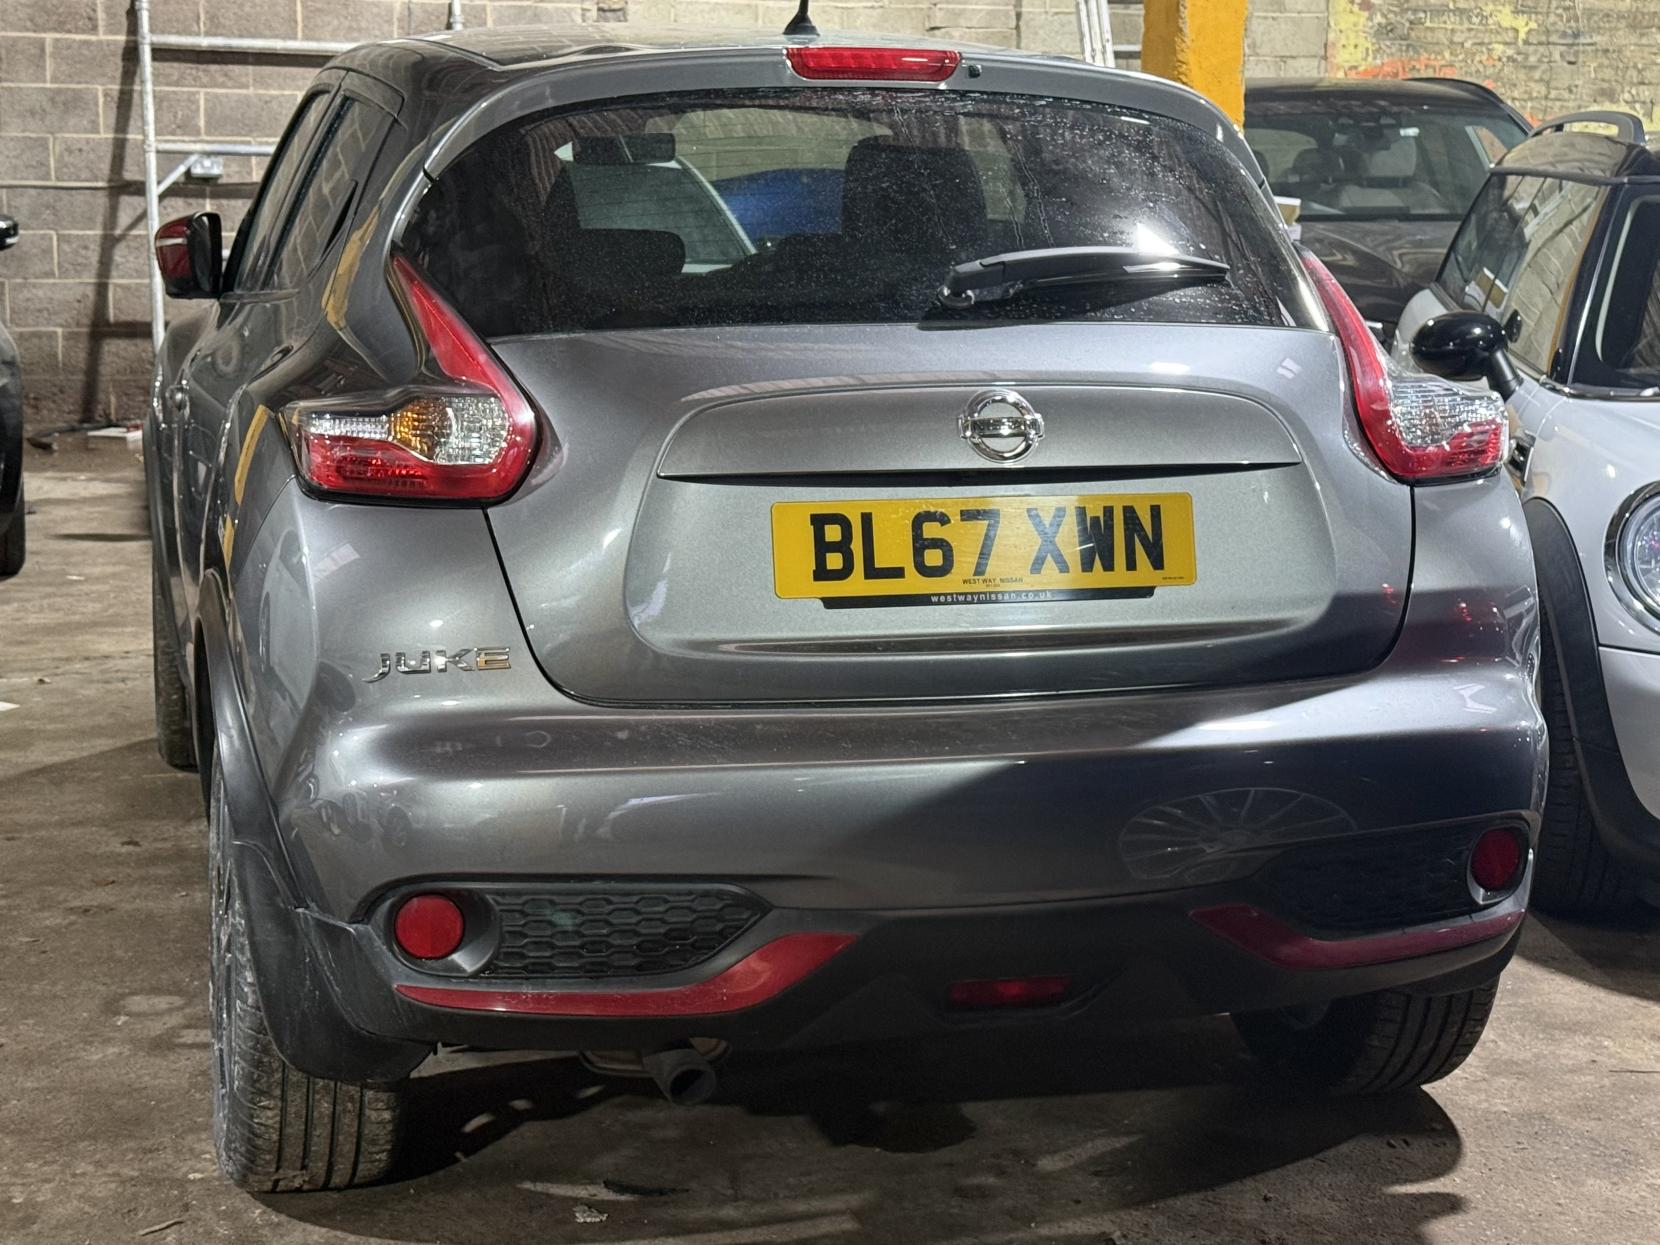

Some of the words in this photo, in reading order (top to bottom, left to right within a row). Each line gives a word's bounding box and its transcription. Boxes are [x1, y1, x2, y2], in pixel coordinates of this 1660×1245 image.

[810, 509, 1001, 582] BL67
[1027, 504, 1164, 575] XWN
[930, 591, 1052, 603] westwaynissan.co.uk
[361, 648, 512, 683] JUKE
